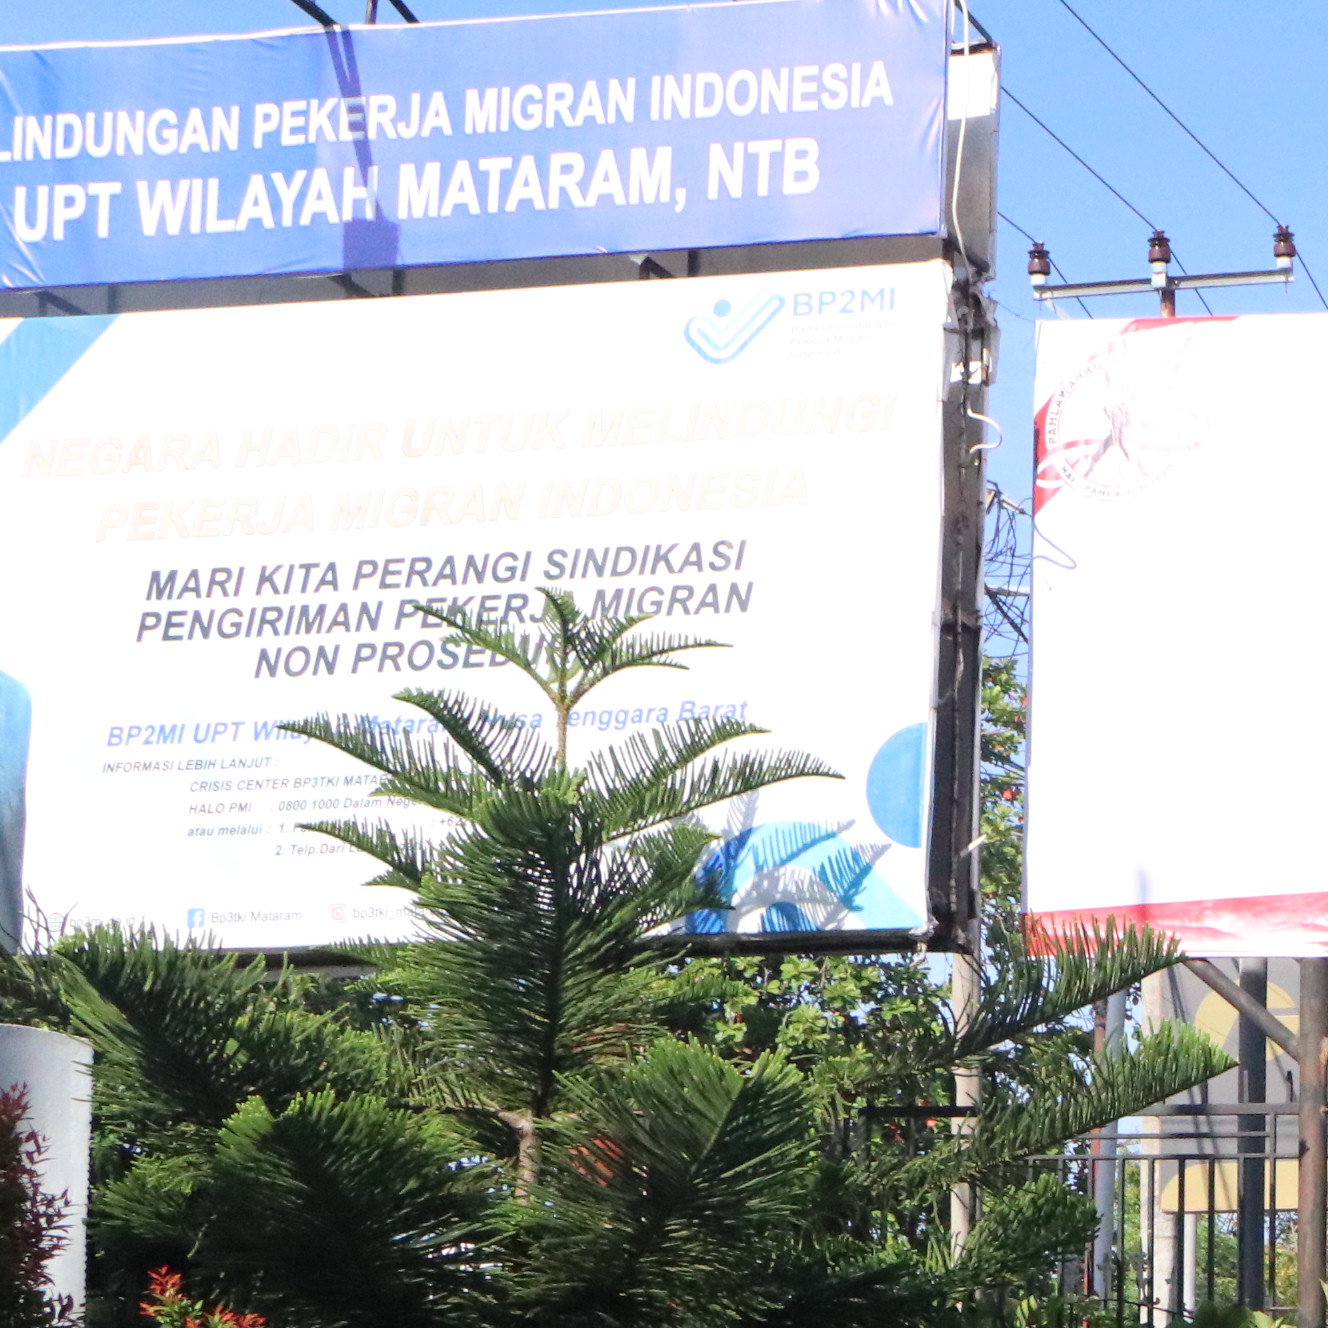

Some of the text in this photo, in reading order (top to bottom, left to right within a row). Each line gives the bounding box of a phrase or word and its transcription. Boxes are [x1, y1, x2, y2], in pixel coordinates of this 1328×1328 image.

[252, 90, 451, 149] PEKERJA
[464, 76, 640, 135] MIGRAN
[650, 60, 894, 124] INDONESIA
[14, 137, 821, 243] UPT WILAYAH MATARAM, NTB
[792, 287, 896, 317] BP2MI
[22, 390, 899, 480] NEGARA HADIR UNTUK MELINDUNGI
[95, 466, 809, 544] PEKERJA MIGRAN INDONESIA
[146, 539, 748, 602] MARI KITA PERANGI SINDIKASI
[136, 582, 754, 643] PENGIRIMAN PEKERJ MIGRAN
[254, 643, 341, 679] NON
[106, 722, 184, 747] BP2MI
[193, 721, 245, 745] UPT
[552, 704, 669, 732] enggara
[679, 700, 749, 725] Barat
[102, 756, 271, 774] INFORMASI LEBIH LANJUT
[190, 780, 233, 793] CRISIS
[237, 778, 289, 792] CENTER
[189, 802, 225, 815] HALO
[228, 801, 252, 813] PMI
